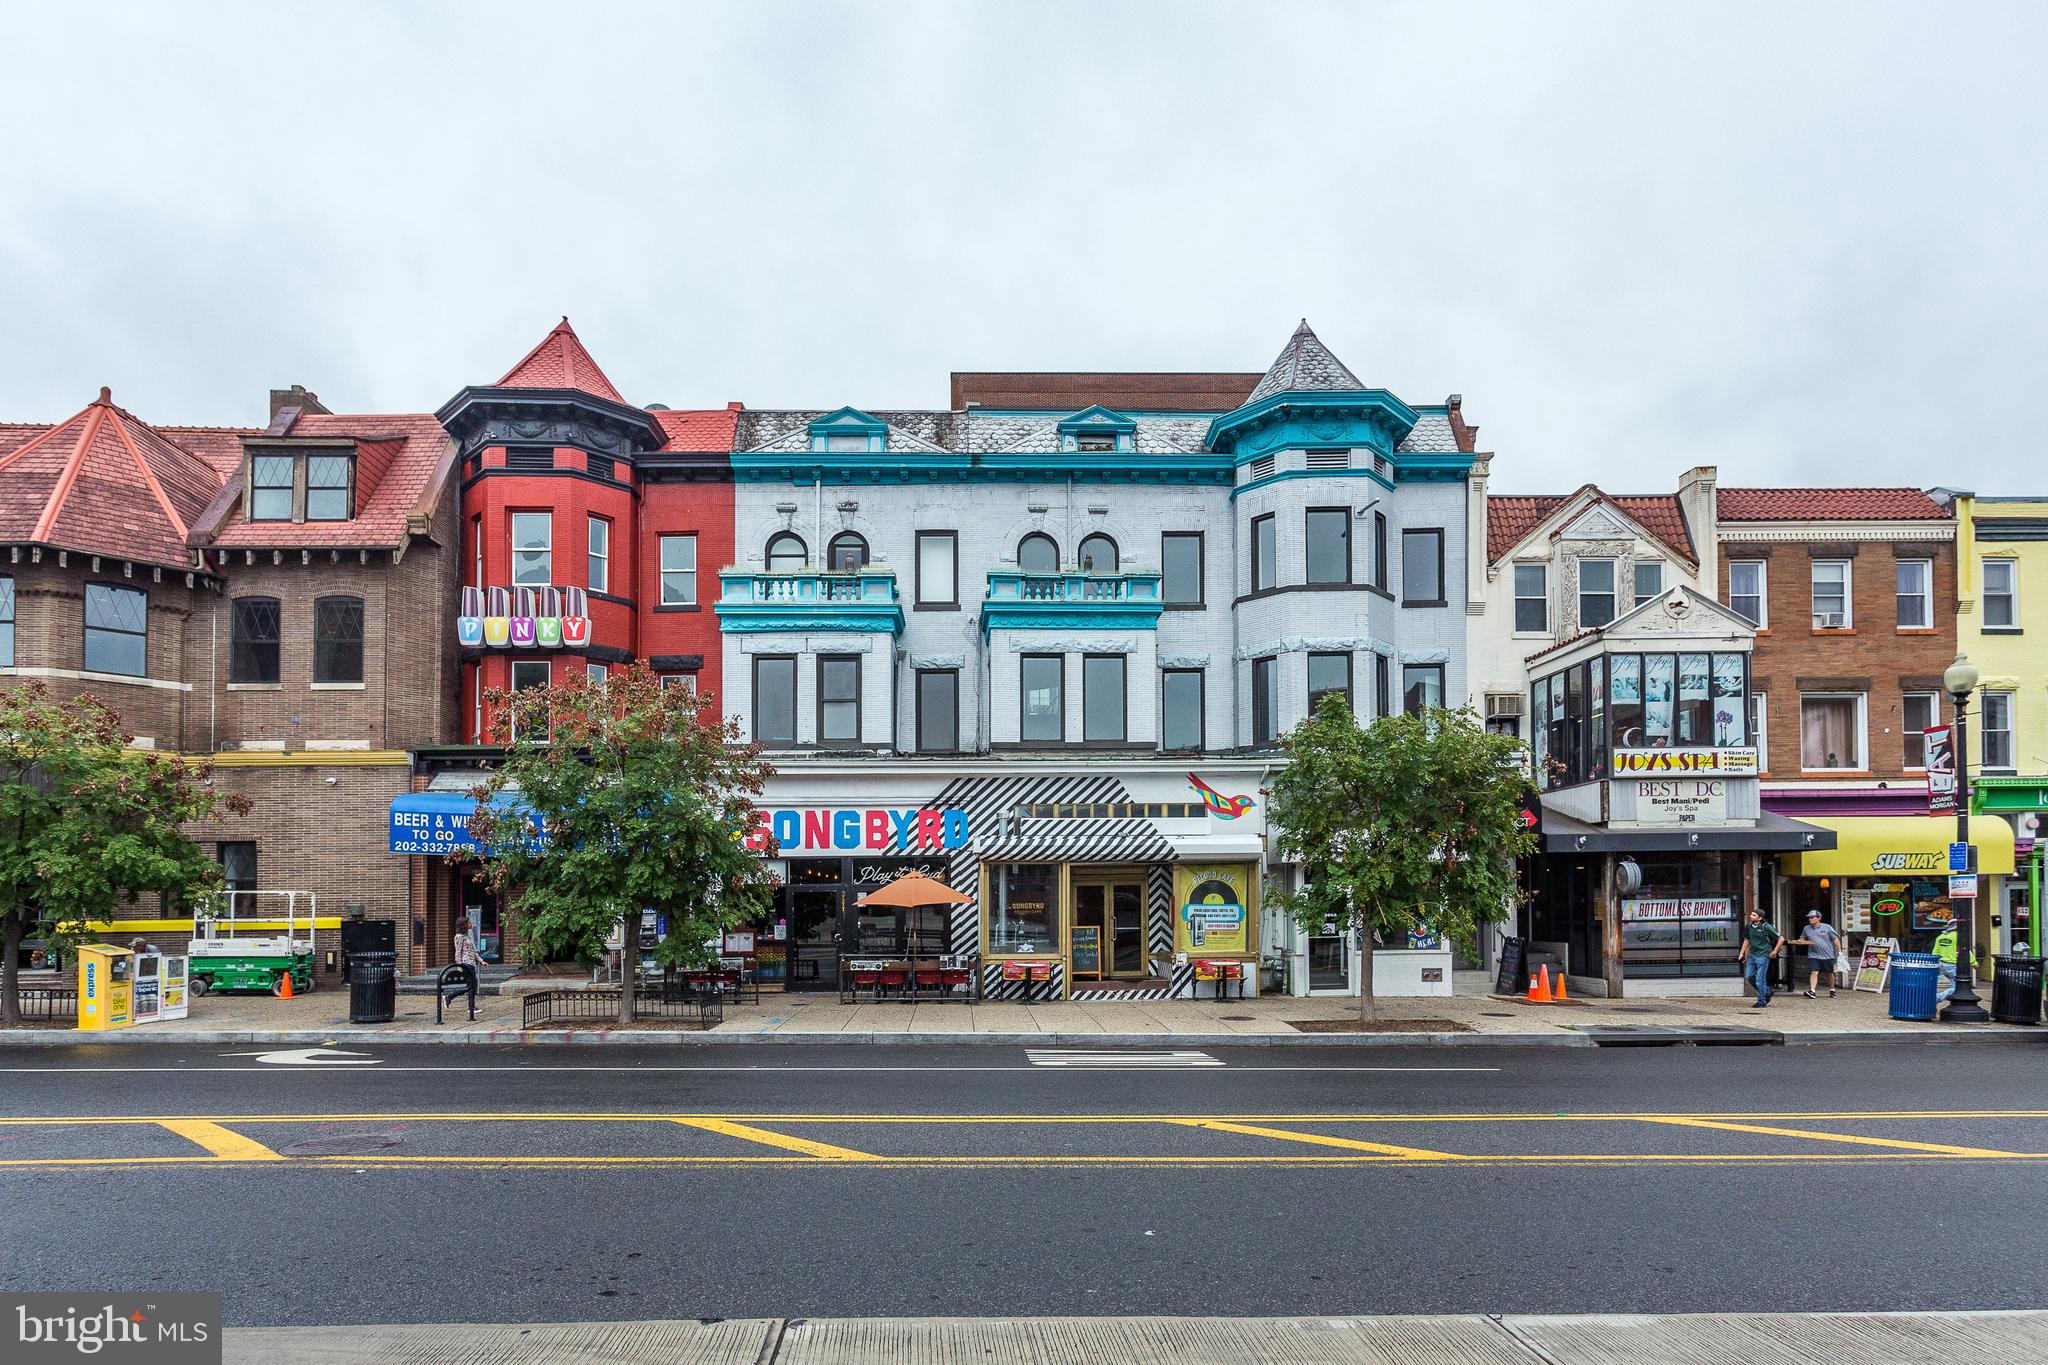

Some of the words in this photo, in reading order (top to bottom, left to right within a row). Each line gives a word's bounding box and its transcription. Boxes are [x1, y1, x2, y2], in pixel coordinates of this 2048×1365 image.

[464, 621, 581, 642] PINKY
[1616, 751, 1672, 773] JOY'S
[1679, 751, 1720, 773] SPA
[1638, 781, 1683, 797] BEST
[1695, 781, 1724, 797] D.C.
[1652, 797, 1670, 805] Best
[1671, 797, 1710, 805] Mani/Pedi
[1930, 801, 1954, 810] MORGAN
[1931, 795, 1953, 804] ADAMS
[394, 812, 429, 827] BEER
[435, 815, 444, 828] &
[1679, 814, 1695, 822] PAPER
[412, 829, 429, 840] TO
[435, 830, 454, 841] GO
[746, 809, 969, 850] SONGBYRD
[1871, 849, 1945, 871] SUBWAY
[853, 865, 894, 885] Play
[1693, 901, 1727, 917] BRUNCH
[1877, 902, 1900, 912] OPEN
[87, 963, 95, 998] express
[112, 1004, 125, 1012] one
[113, 997, 126, 1006] take
